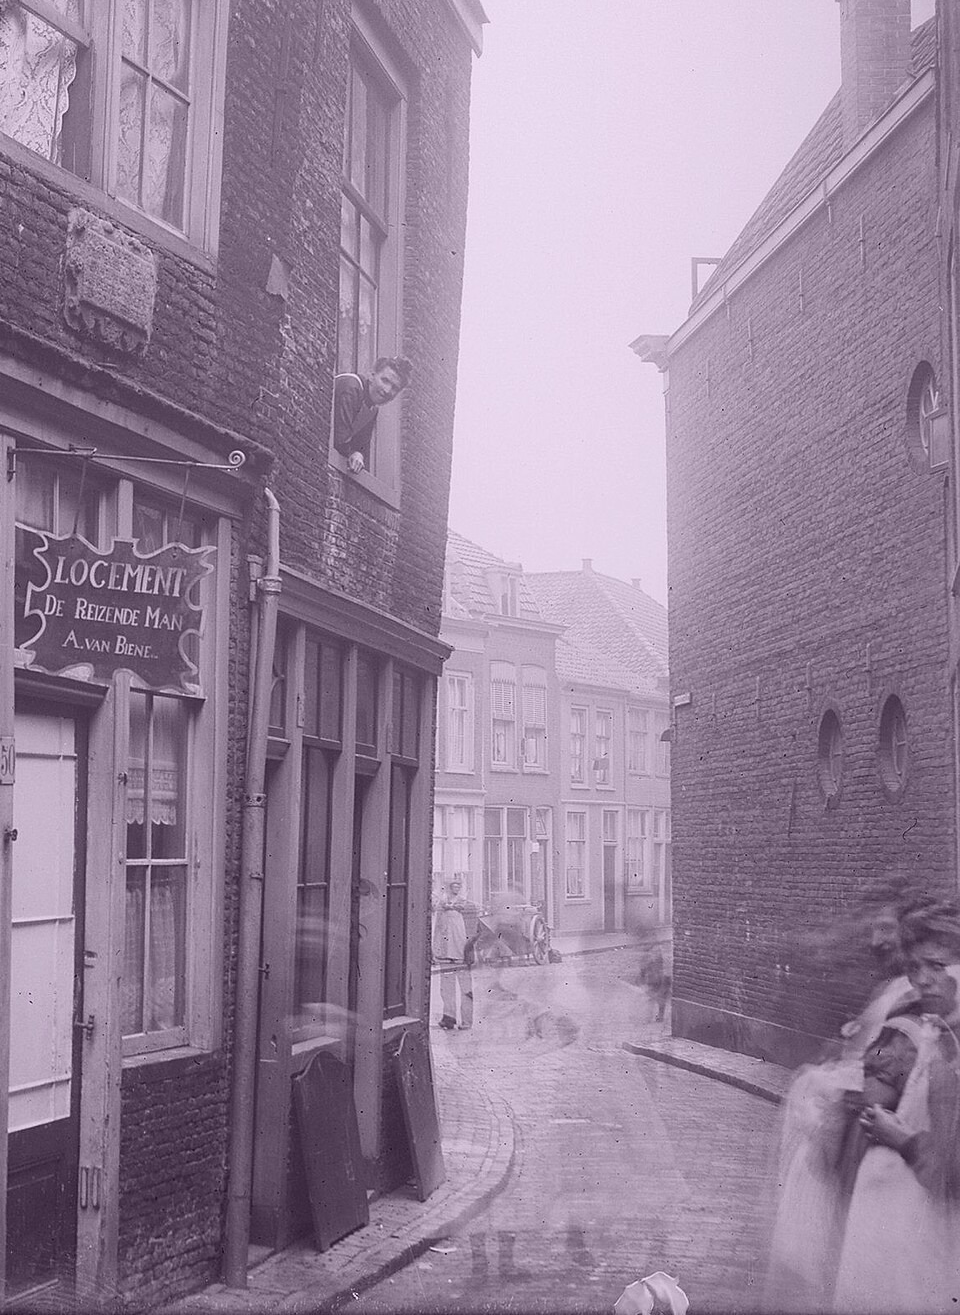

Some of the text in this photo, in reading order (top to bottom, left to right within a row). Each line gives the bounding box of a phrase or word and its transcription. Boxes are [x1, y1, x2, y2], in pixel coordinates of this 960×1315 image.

[44, 594, 183, 631] DE REIZENDE MAN
[1, 744, 15, 776] 50
